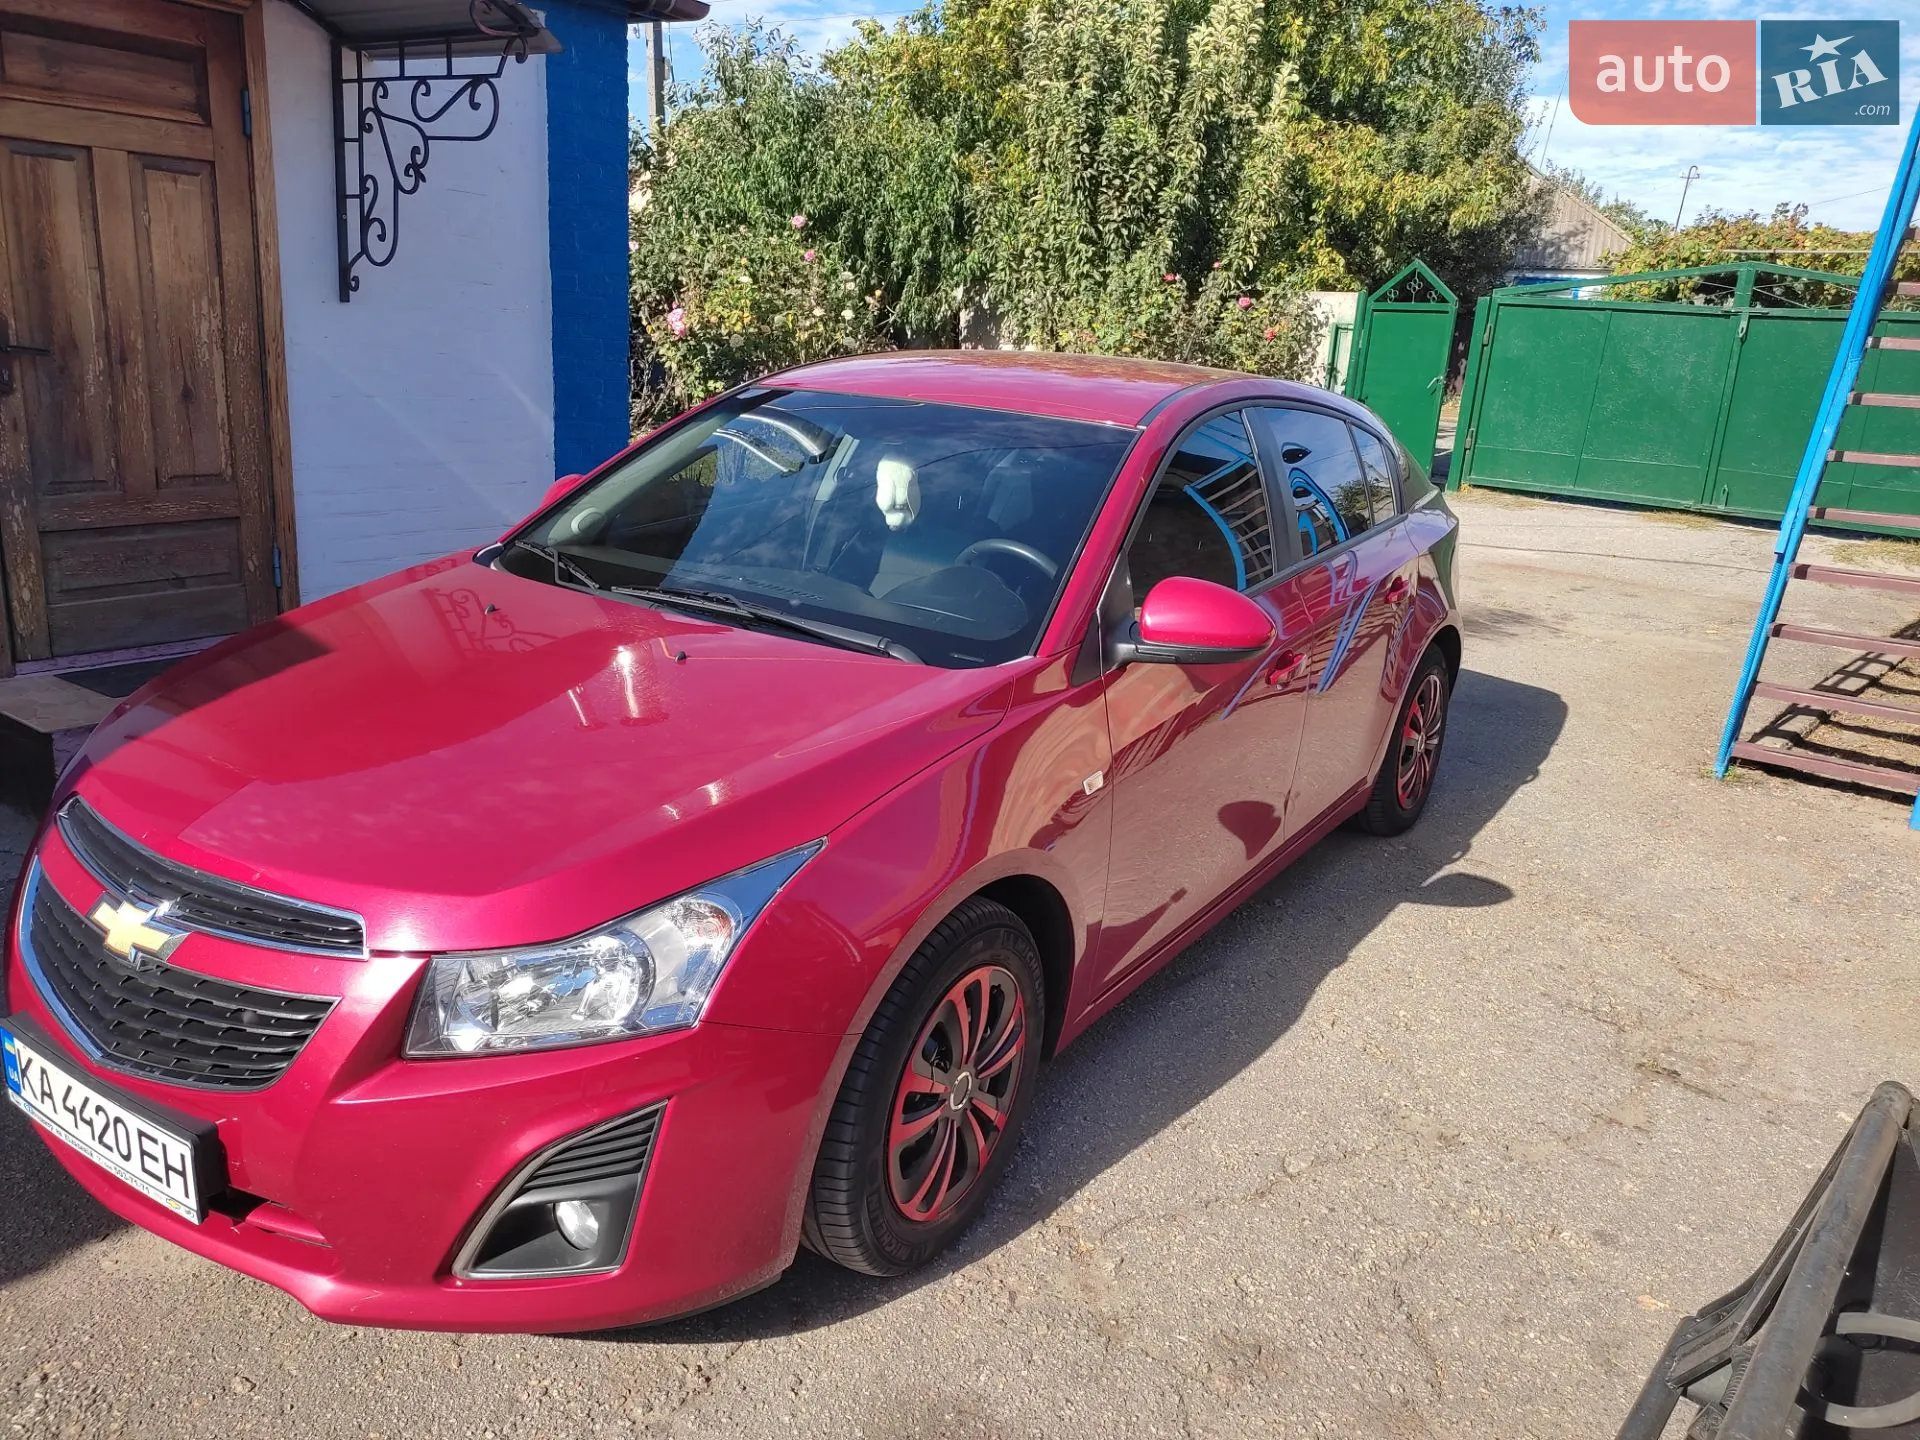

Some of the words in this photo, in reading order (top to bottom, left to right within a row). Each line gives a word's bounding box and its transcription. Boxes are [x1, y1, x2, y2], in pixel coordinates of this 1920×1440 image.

[8, 1066, 20, 1085] UA
[17, 1049, 58, 1114] KA
[62, 1085, 131, 1162] 4420
[138, 1128, 189, 1199] EH
